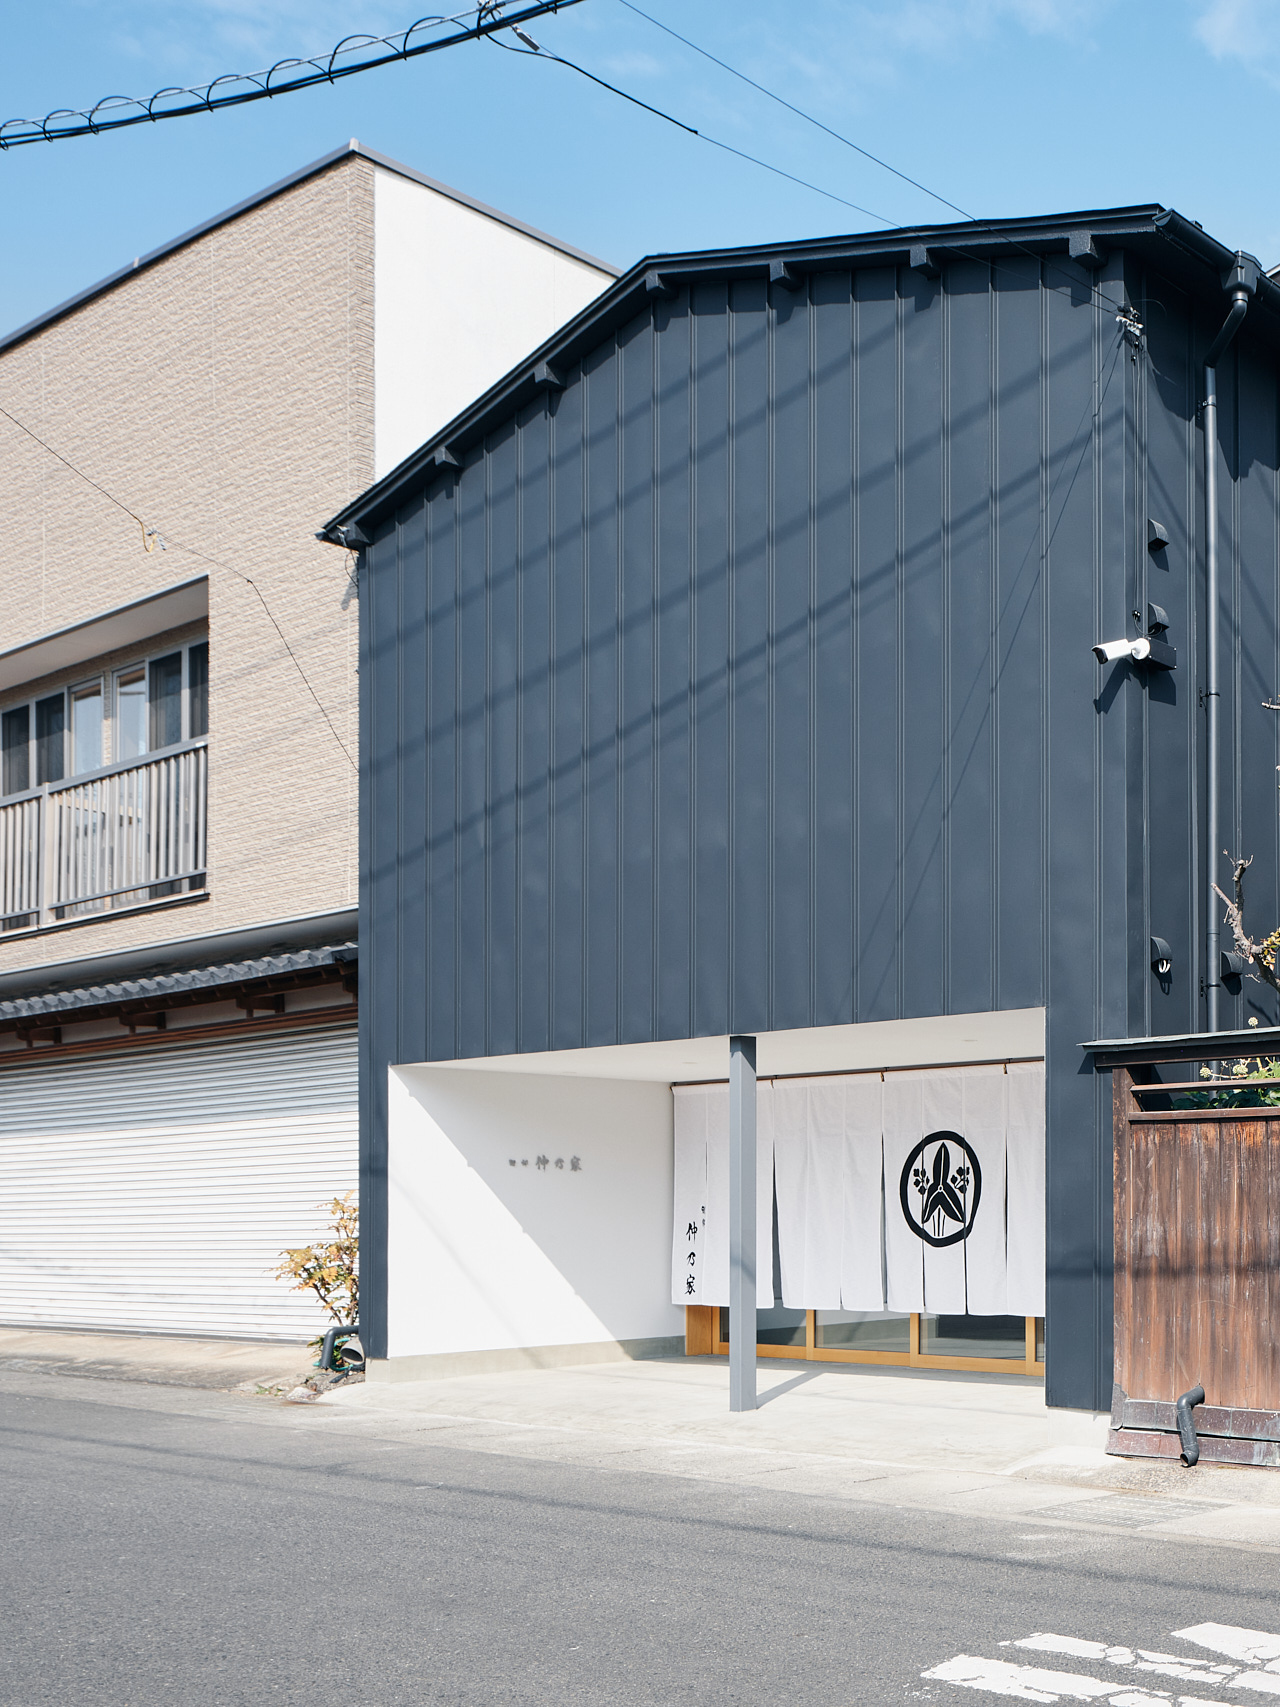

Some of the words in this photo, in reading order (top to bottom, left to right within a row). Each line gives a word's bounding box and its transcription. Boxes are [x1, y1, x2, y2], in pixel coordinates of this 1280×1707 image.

[536, 1154, 582, 1172] 仲乃家
[686, 1222, 698, 1295] 仲乃家
